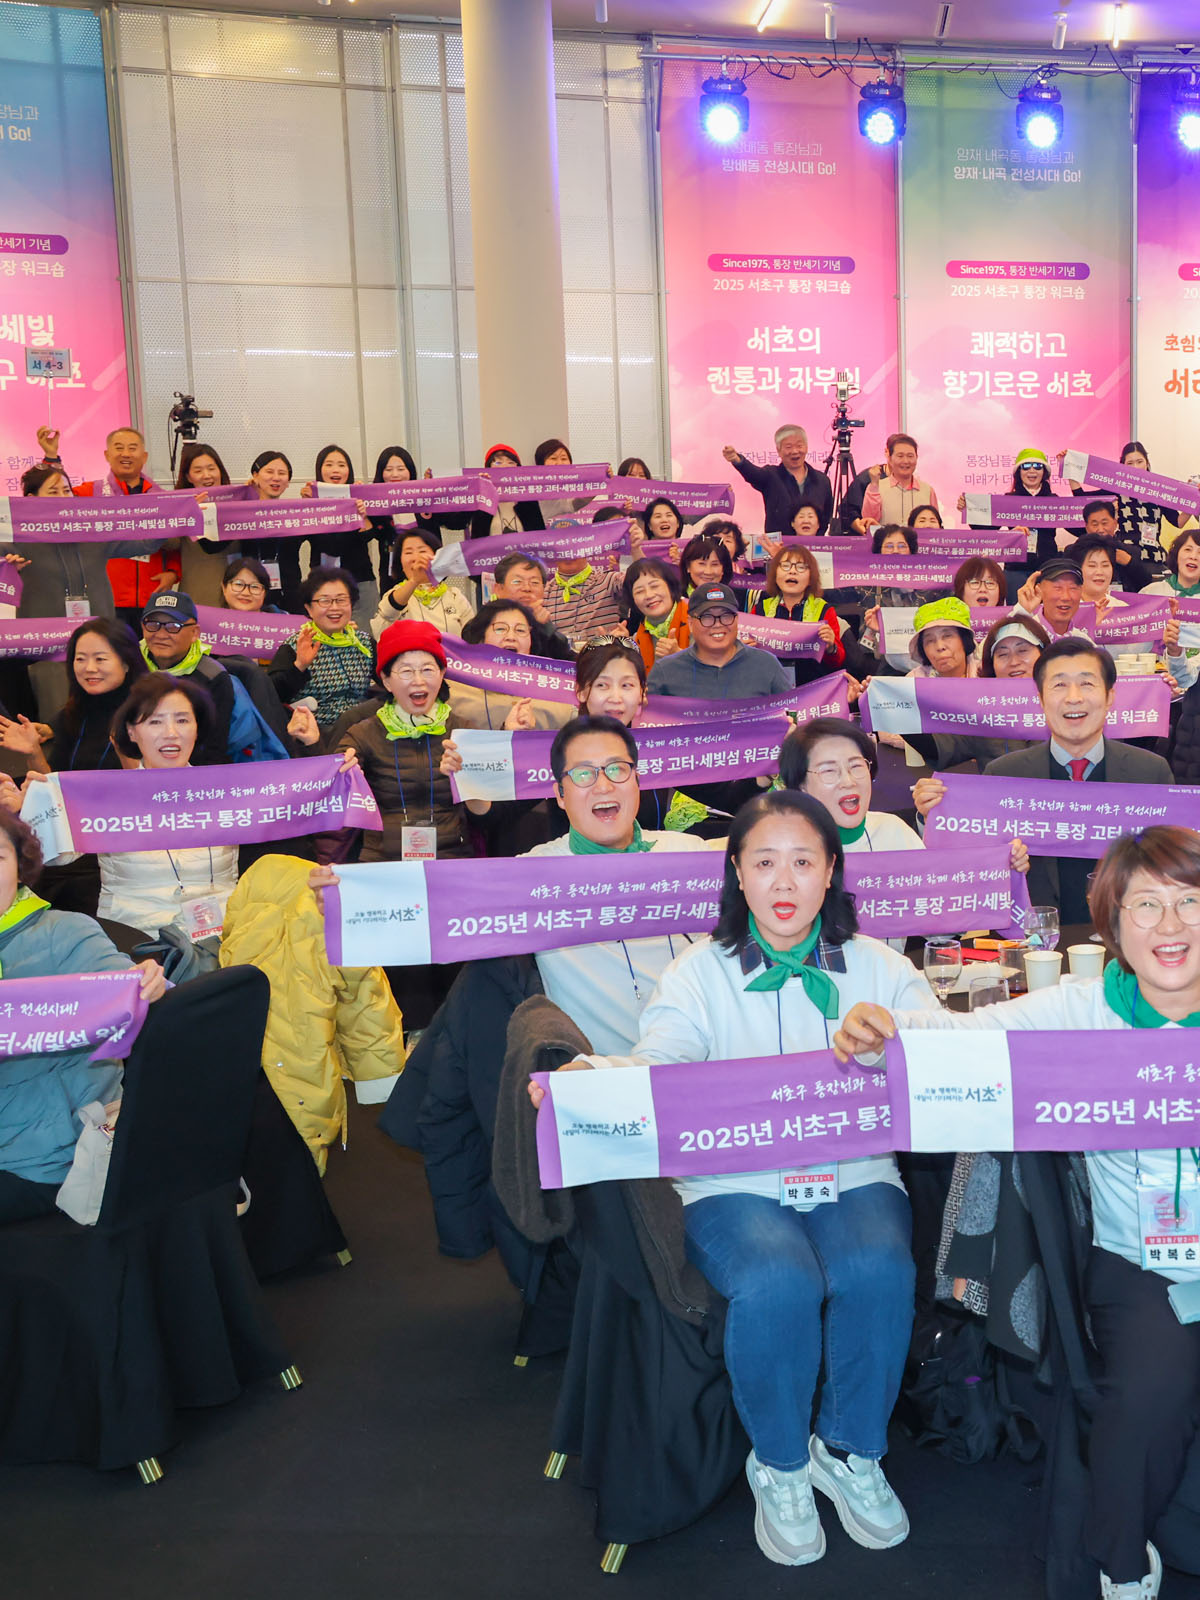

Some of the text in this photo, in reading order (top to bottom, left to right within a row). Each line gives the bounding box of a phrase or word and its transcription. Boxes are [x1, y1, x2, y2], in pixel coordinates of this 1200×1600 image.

[0, 104, 39, 120] 장님과
[8, 125, 32, 141] Go!
[722, 158, 837, 176] 방배동 전성시대 Go!
[1011, 167, 1059, 183] 전성시대
[1063, 169, 1082, 183] Go!
[29, 237, 52, 251] 기념
[21, 261, 66, 279] 워크숍
[722, 258, 841, 272] Since1975, 통장 반세기 기념
[959, 264, 1076, 278] Since1975, 통장 반세기 기념
[713, 278, 852, 295] 2025 서초구 통장 워크숍
[951, 284, 1086, 300] 2025 서초구 통장 워크숍
[747, 325, 821, 354] 서초의
[970, 331, 1068, 360] 쾌적하고
[32, 360, 64, 371] 서 4-3
[707, 366, 782, 395] 전통과
[942, 369, 1095, 399] 향기로운 서초
[964, 473, 999, 487] 미래가
[20, 516, 196, 533] 2025년 서초구 통장 워크숍
[929, 710, 1046, 728] 2025년 서초구 통장
[1121, 710, 1159, 725] 워크숍
[637, 745, 781, 776] 통장 고터·세빛섬 워크숍
[80, 794, 345, 834] 2025년 서초구 통장 고터·세빛섬
[934, 815, 1088, 841] 2025년 서초구 통장
[389, 907, 417, 922] 서초
[858, 895, 946, 919] 서초구 통장
[447, 904, 638, 938] 2025년 서초구 통장
[1136, 1063, 1176, 1083] 서초구
[771, 1075, 866, 1104] 서초구 통장님과
[965, 1086, 998, 1103] 서초
[1034, 1098, 1136, 1126] 2025년
[611, 1120, 643, 1136] 서초
[678, 1103, 892, 1153] 2025년 서초구 통장
